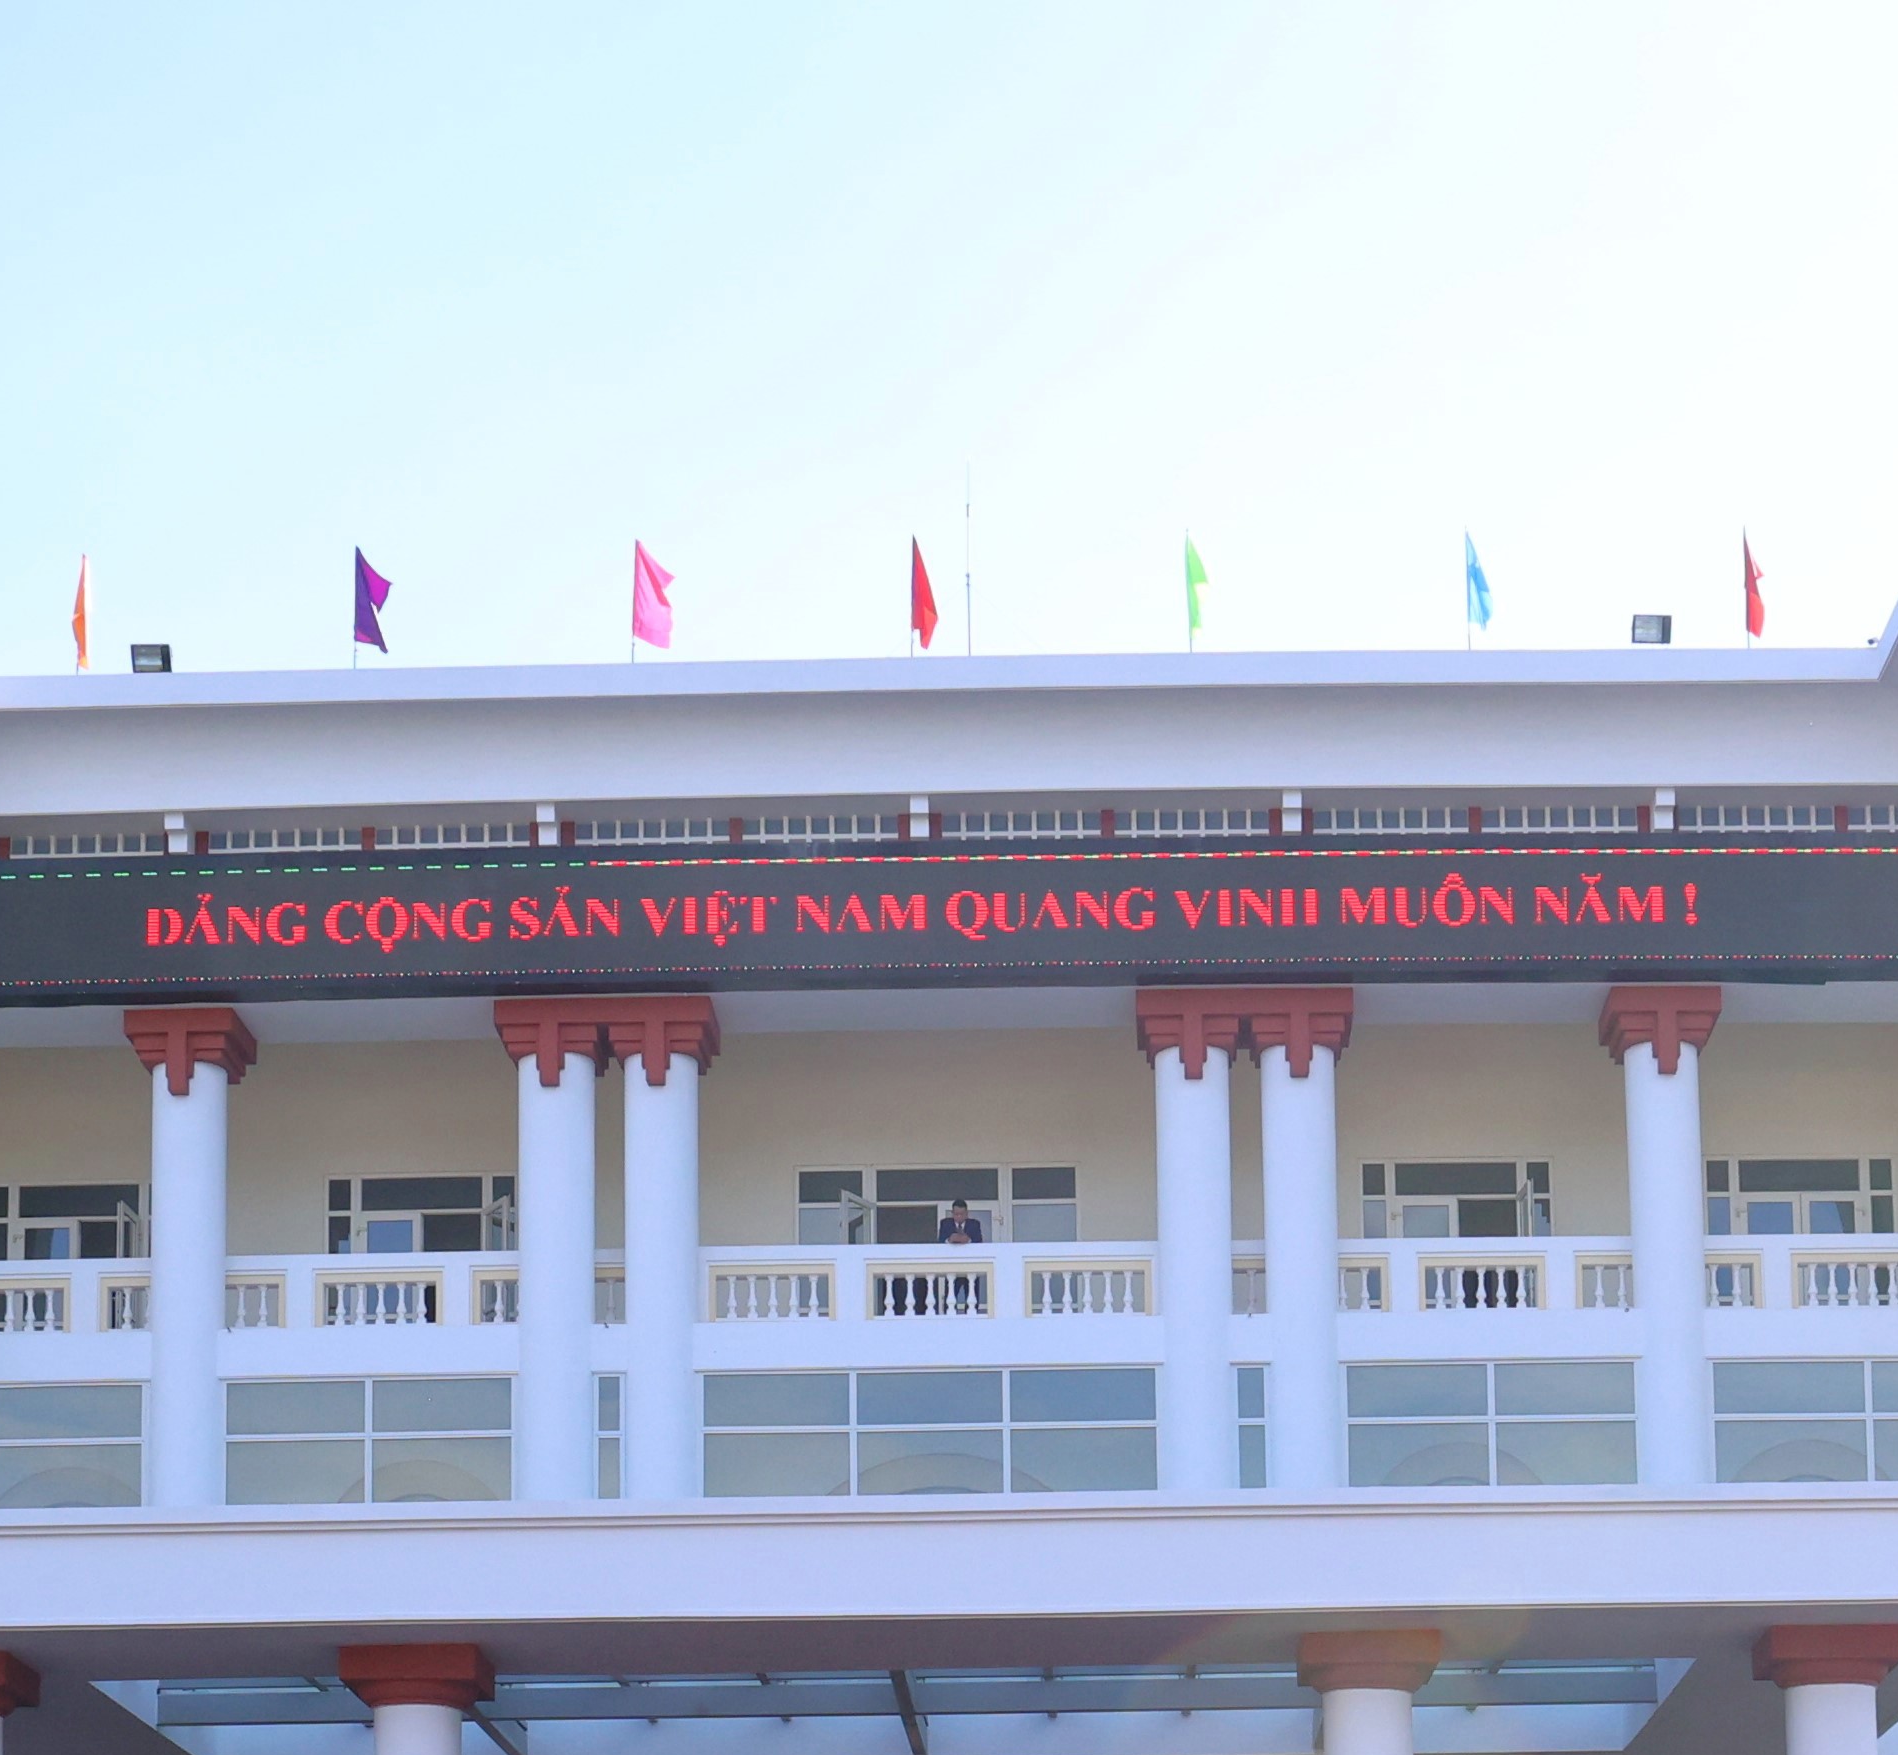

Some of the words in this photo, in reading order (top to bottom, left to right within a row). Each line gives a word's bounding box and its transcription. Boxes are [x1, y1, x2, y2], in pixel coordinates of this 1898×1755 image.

[323, 896, 493, 954] CỘNG
[640, 891, 779, 947] VIỆT
[796, 894, 928, 933] NAM
[944, 887, 1157, 941] QUANG
[1340, 872, 1515, 928] MUÔN
[1534, 874, 1666, 924] NĂM
[1683, 883, 1699, 926] !
